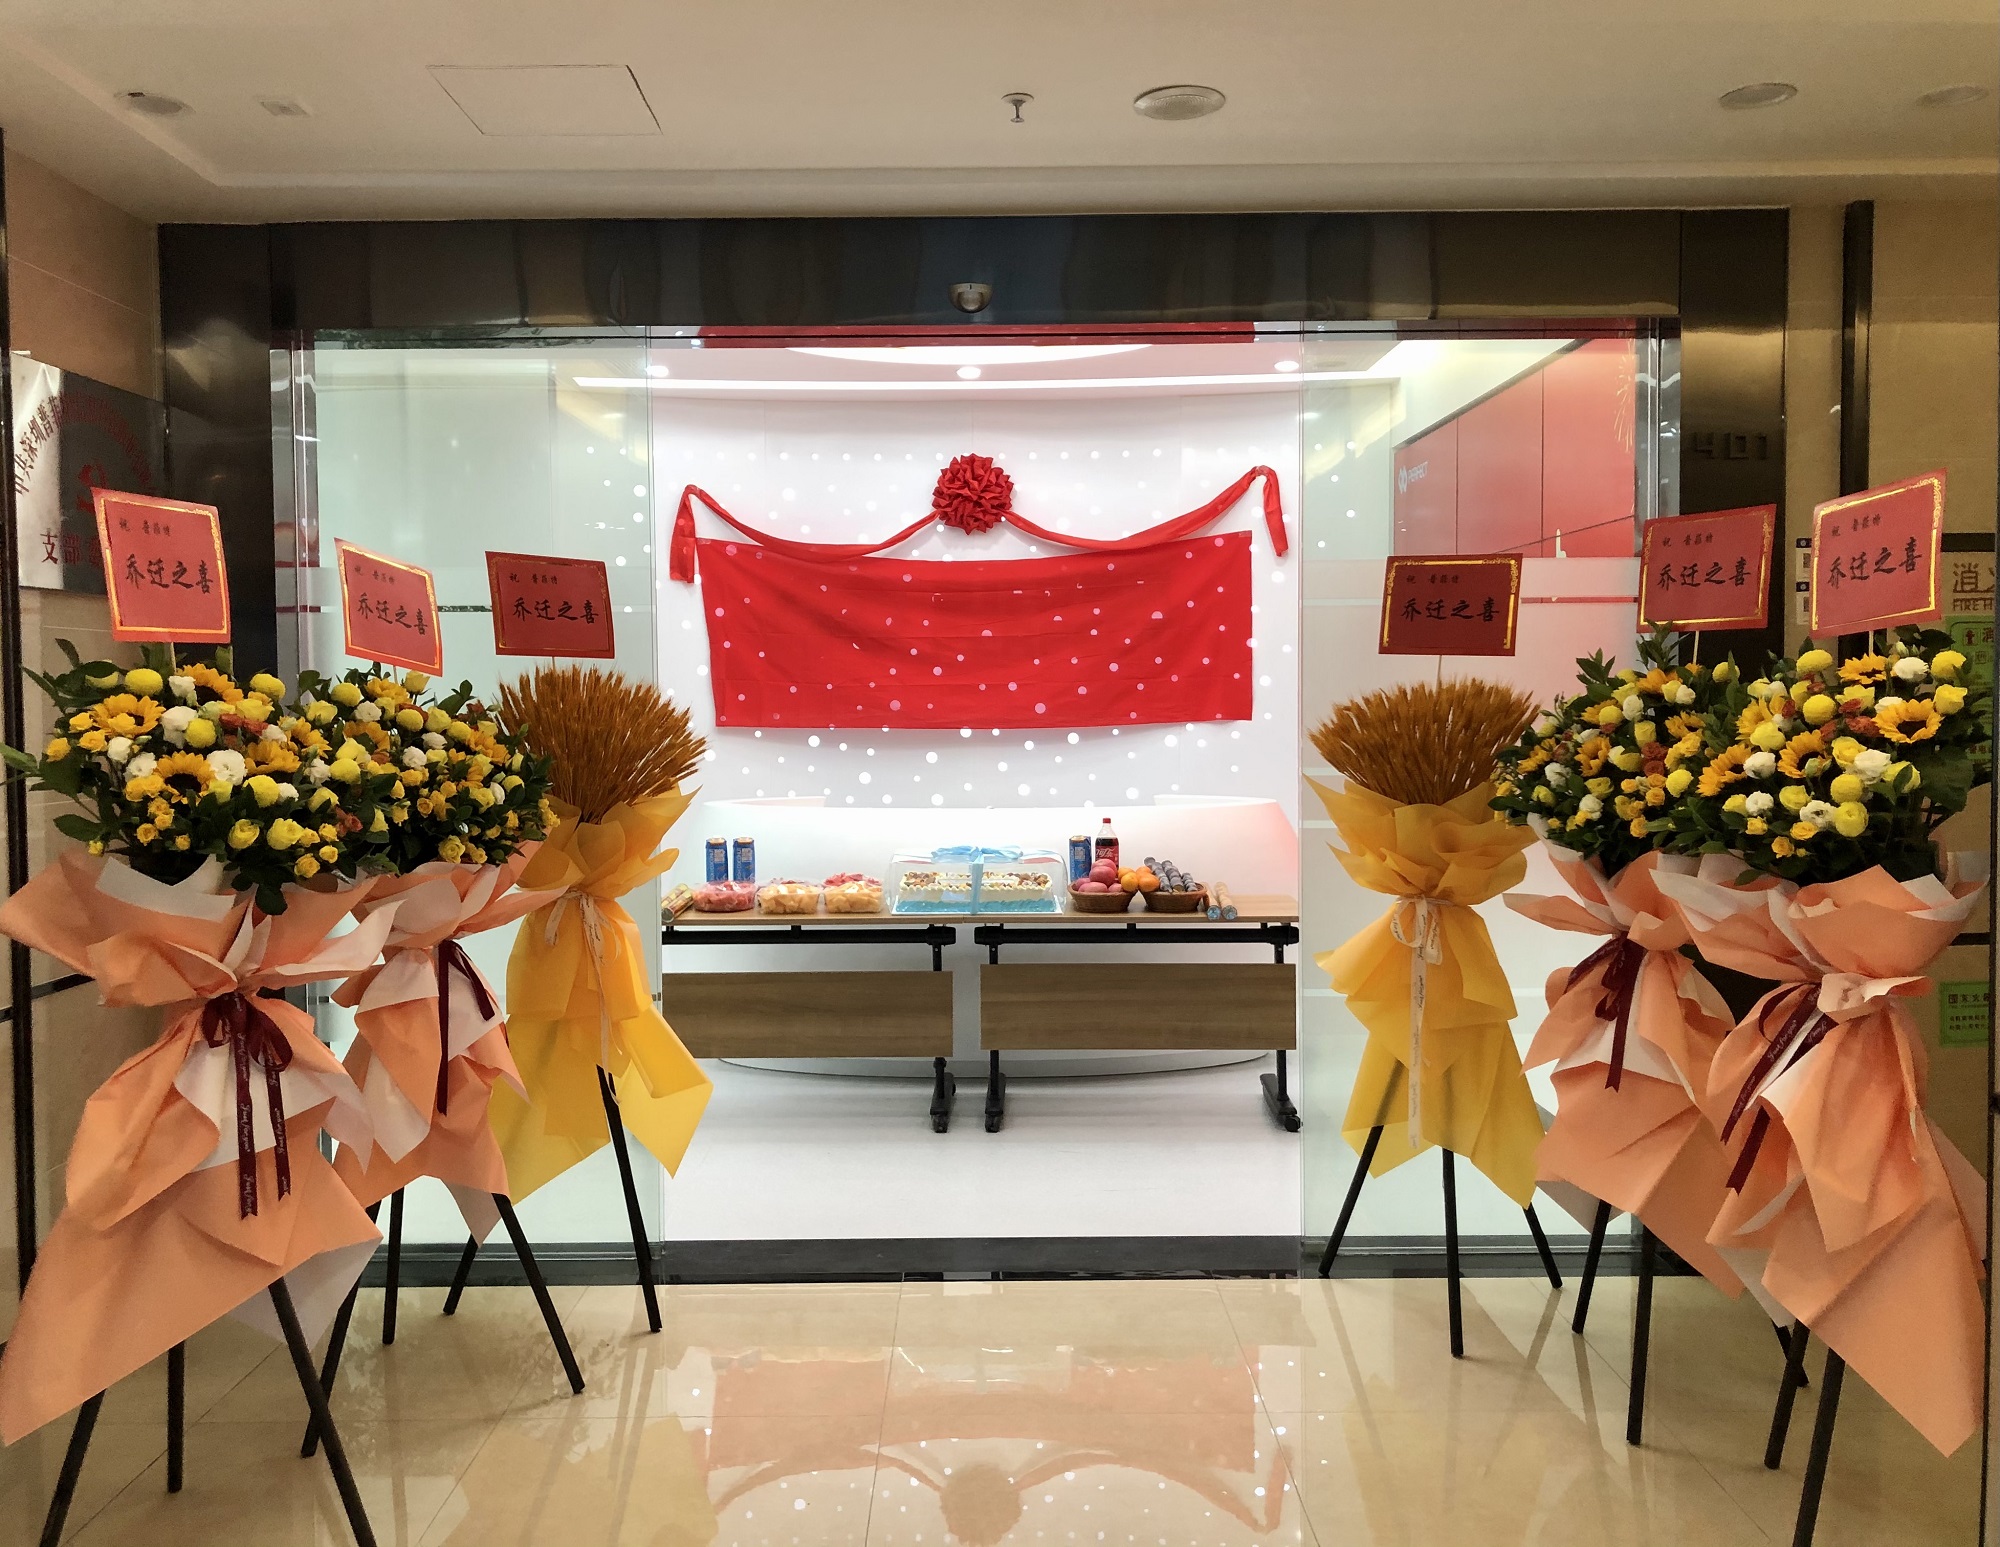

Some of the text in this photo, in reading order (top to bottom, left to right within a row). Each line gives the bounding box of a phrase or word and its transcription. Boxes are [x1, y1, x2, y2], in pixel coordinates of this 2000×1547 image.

[1691, 432, 1770, 460] 401
[126, 553, 213, 594] 乔迁之喜
[1657, 556, 1751, 591] 乔迁之喜
[1828, 536, 1923, 589] 乔迁之喜
[357, 592, 428, 635] 乔迁之喜
[513, 597, 599, 624] 乔迁之喜
[1401, 597, 1500, 622] 乔迁之喜
[1953, 597, 1980, 611] FIRE
